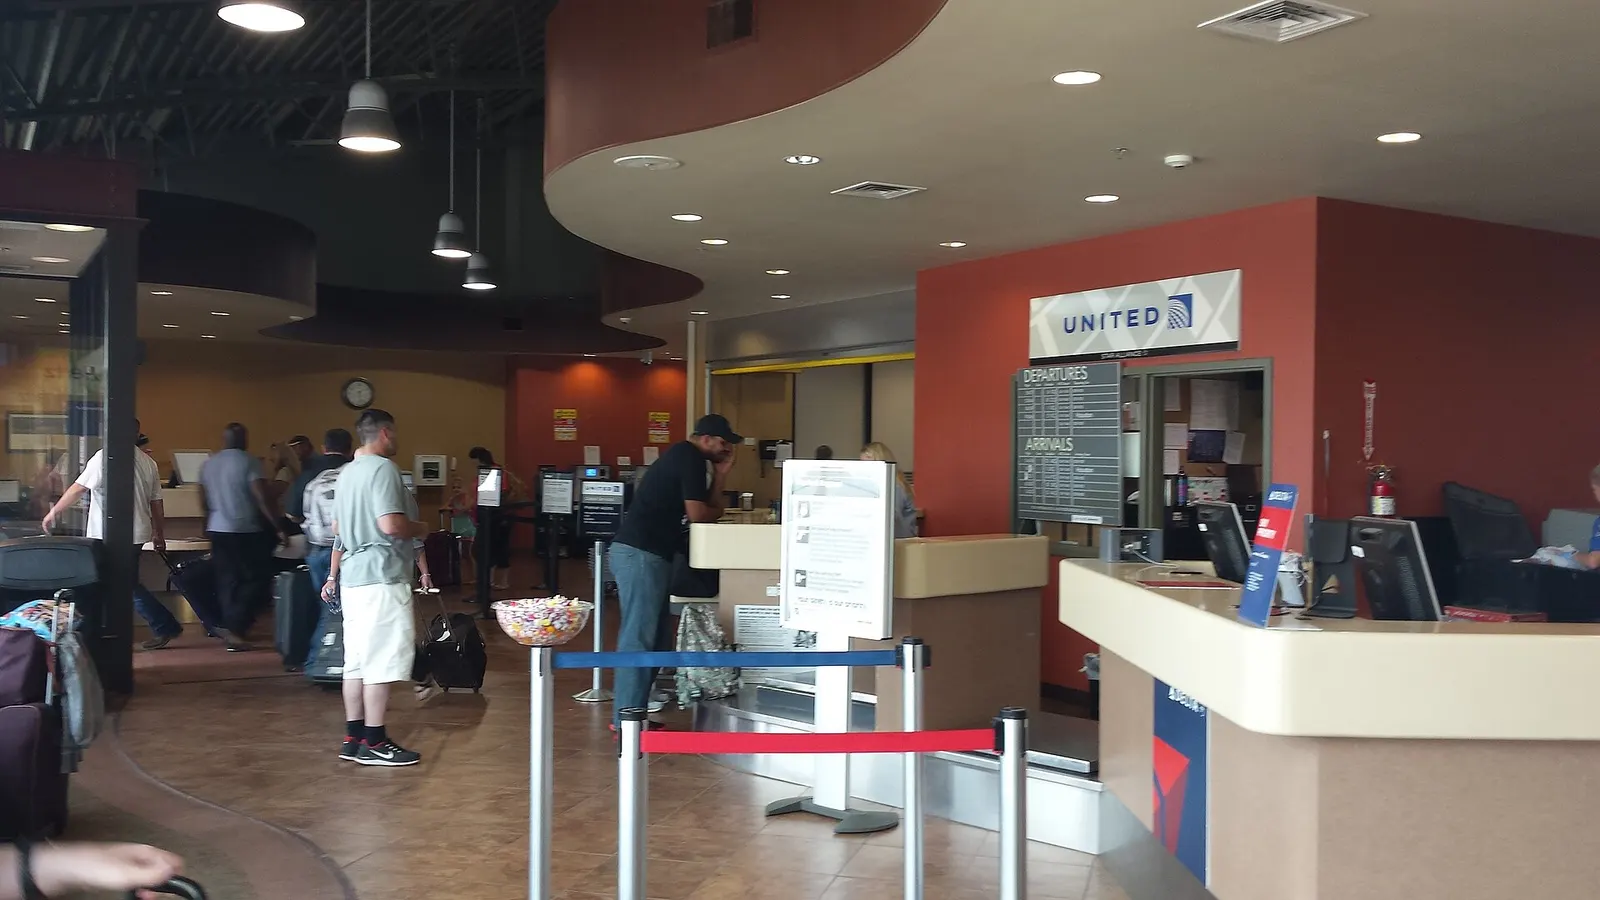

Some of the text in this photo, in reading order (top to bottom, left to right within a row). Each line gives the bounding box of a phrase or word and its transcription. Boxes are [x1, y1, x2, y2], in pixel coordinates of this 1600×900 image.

[1063, 306, 1160, 334] UNITED
[1023, 366, 1088, 383] DEPARTURES
[1024, 437, 1074, 452] ARRIVALS
